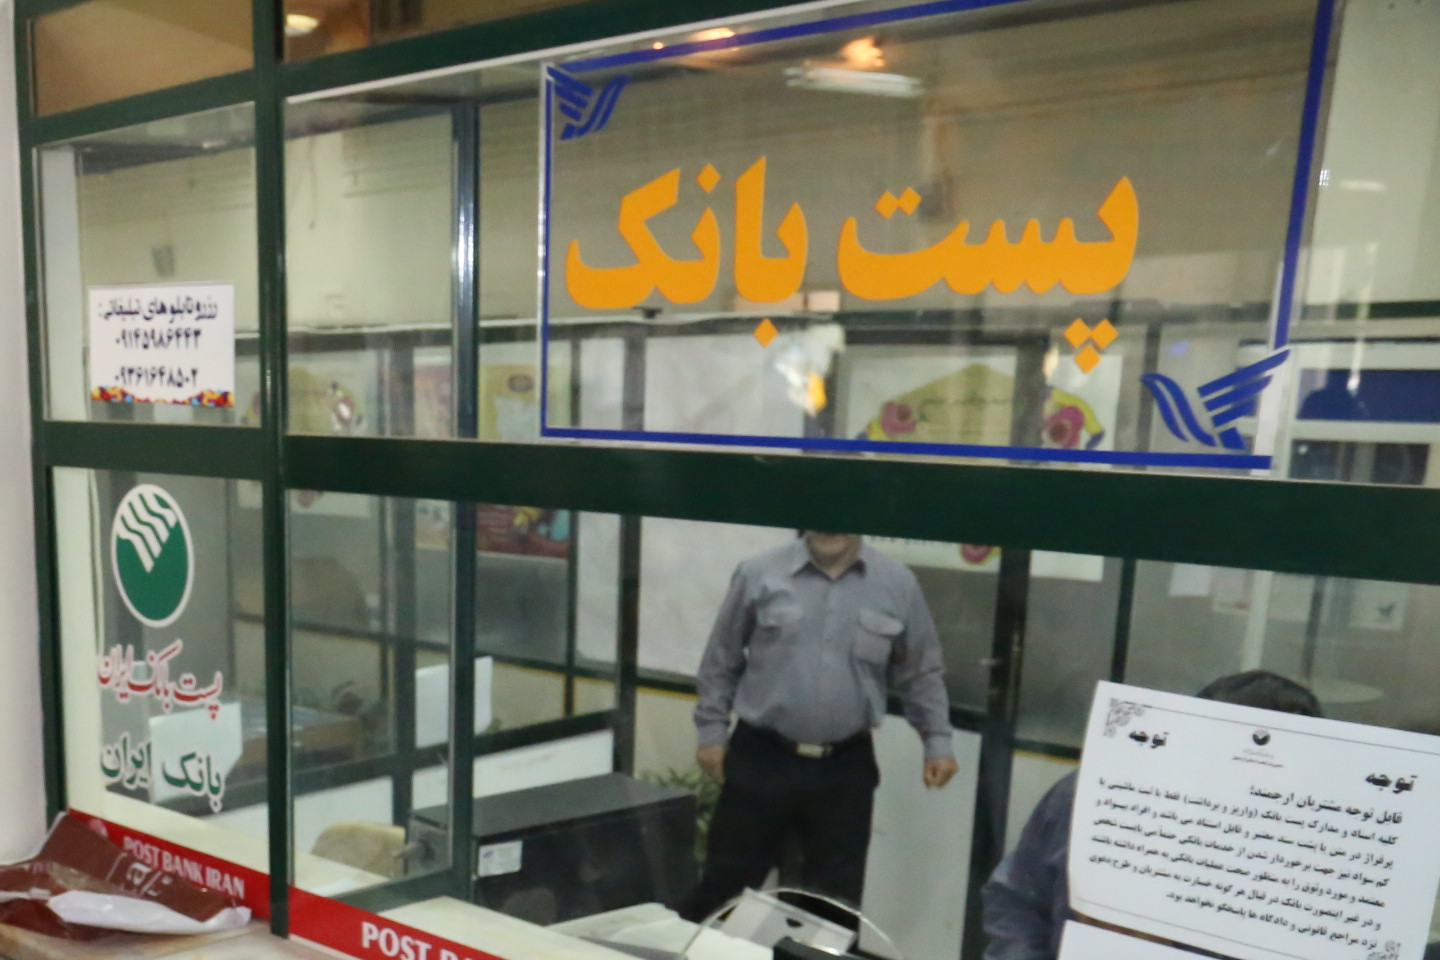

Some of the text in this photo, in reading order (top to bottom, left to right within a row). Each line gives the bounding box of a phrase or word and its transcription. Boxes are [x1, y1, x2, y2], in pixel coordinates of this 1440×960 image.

[565, 155, 1139, 374] پست بانک
[97, 638, 224, 721] پست بانک ایران
[1128, 731, 1168, 749] توجه
[100, 731, 226, 815] بانک ایران
[1364, 773, 1417, 794] توجه
[1296, 795, 1341, 812] مشتریان
[1260, 810, 1281, 821] بانک
[1344, 806, 1373, 821] توجه
[1375, 810, 1402, 824] قابل
[1307, 820, 1339, 833] مدارک
[1178, 835, 1202, 846] بانکی
[1350, 829, 1375, 840] اسناد
[1377, 835, 1398, 845] کلیه
[1170, 853, 1194, 863] بانکی
[122, 835, 161, 869] POST
[161, 850, 205, 884] BANK
[205, 867, 246, 900] IRAN
[1252, 871, 1279, 882] منظور
[1351, 872, 1374, 885] سواد
[1375, 878, 1389, 887] کم
[1325, 888, 1348, 900] مورد
[1280, 897, 1302, 908] بانک
